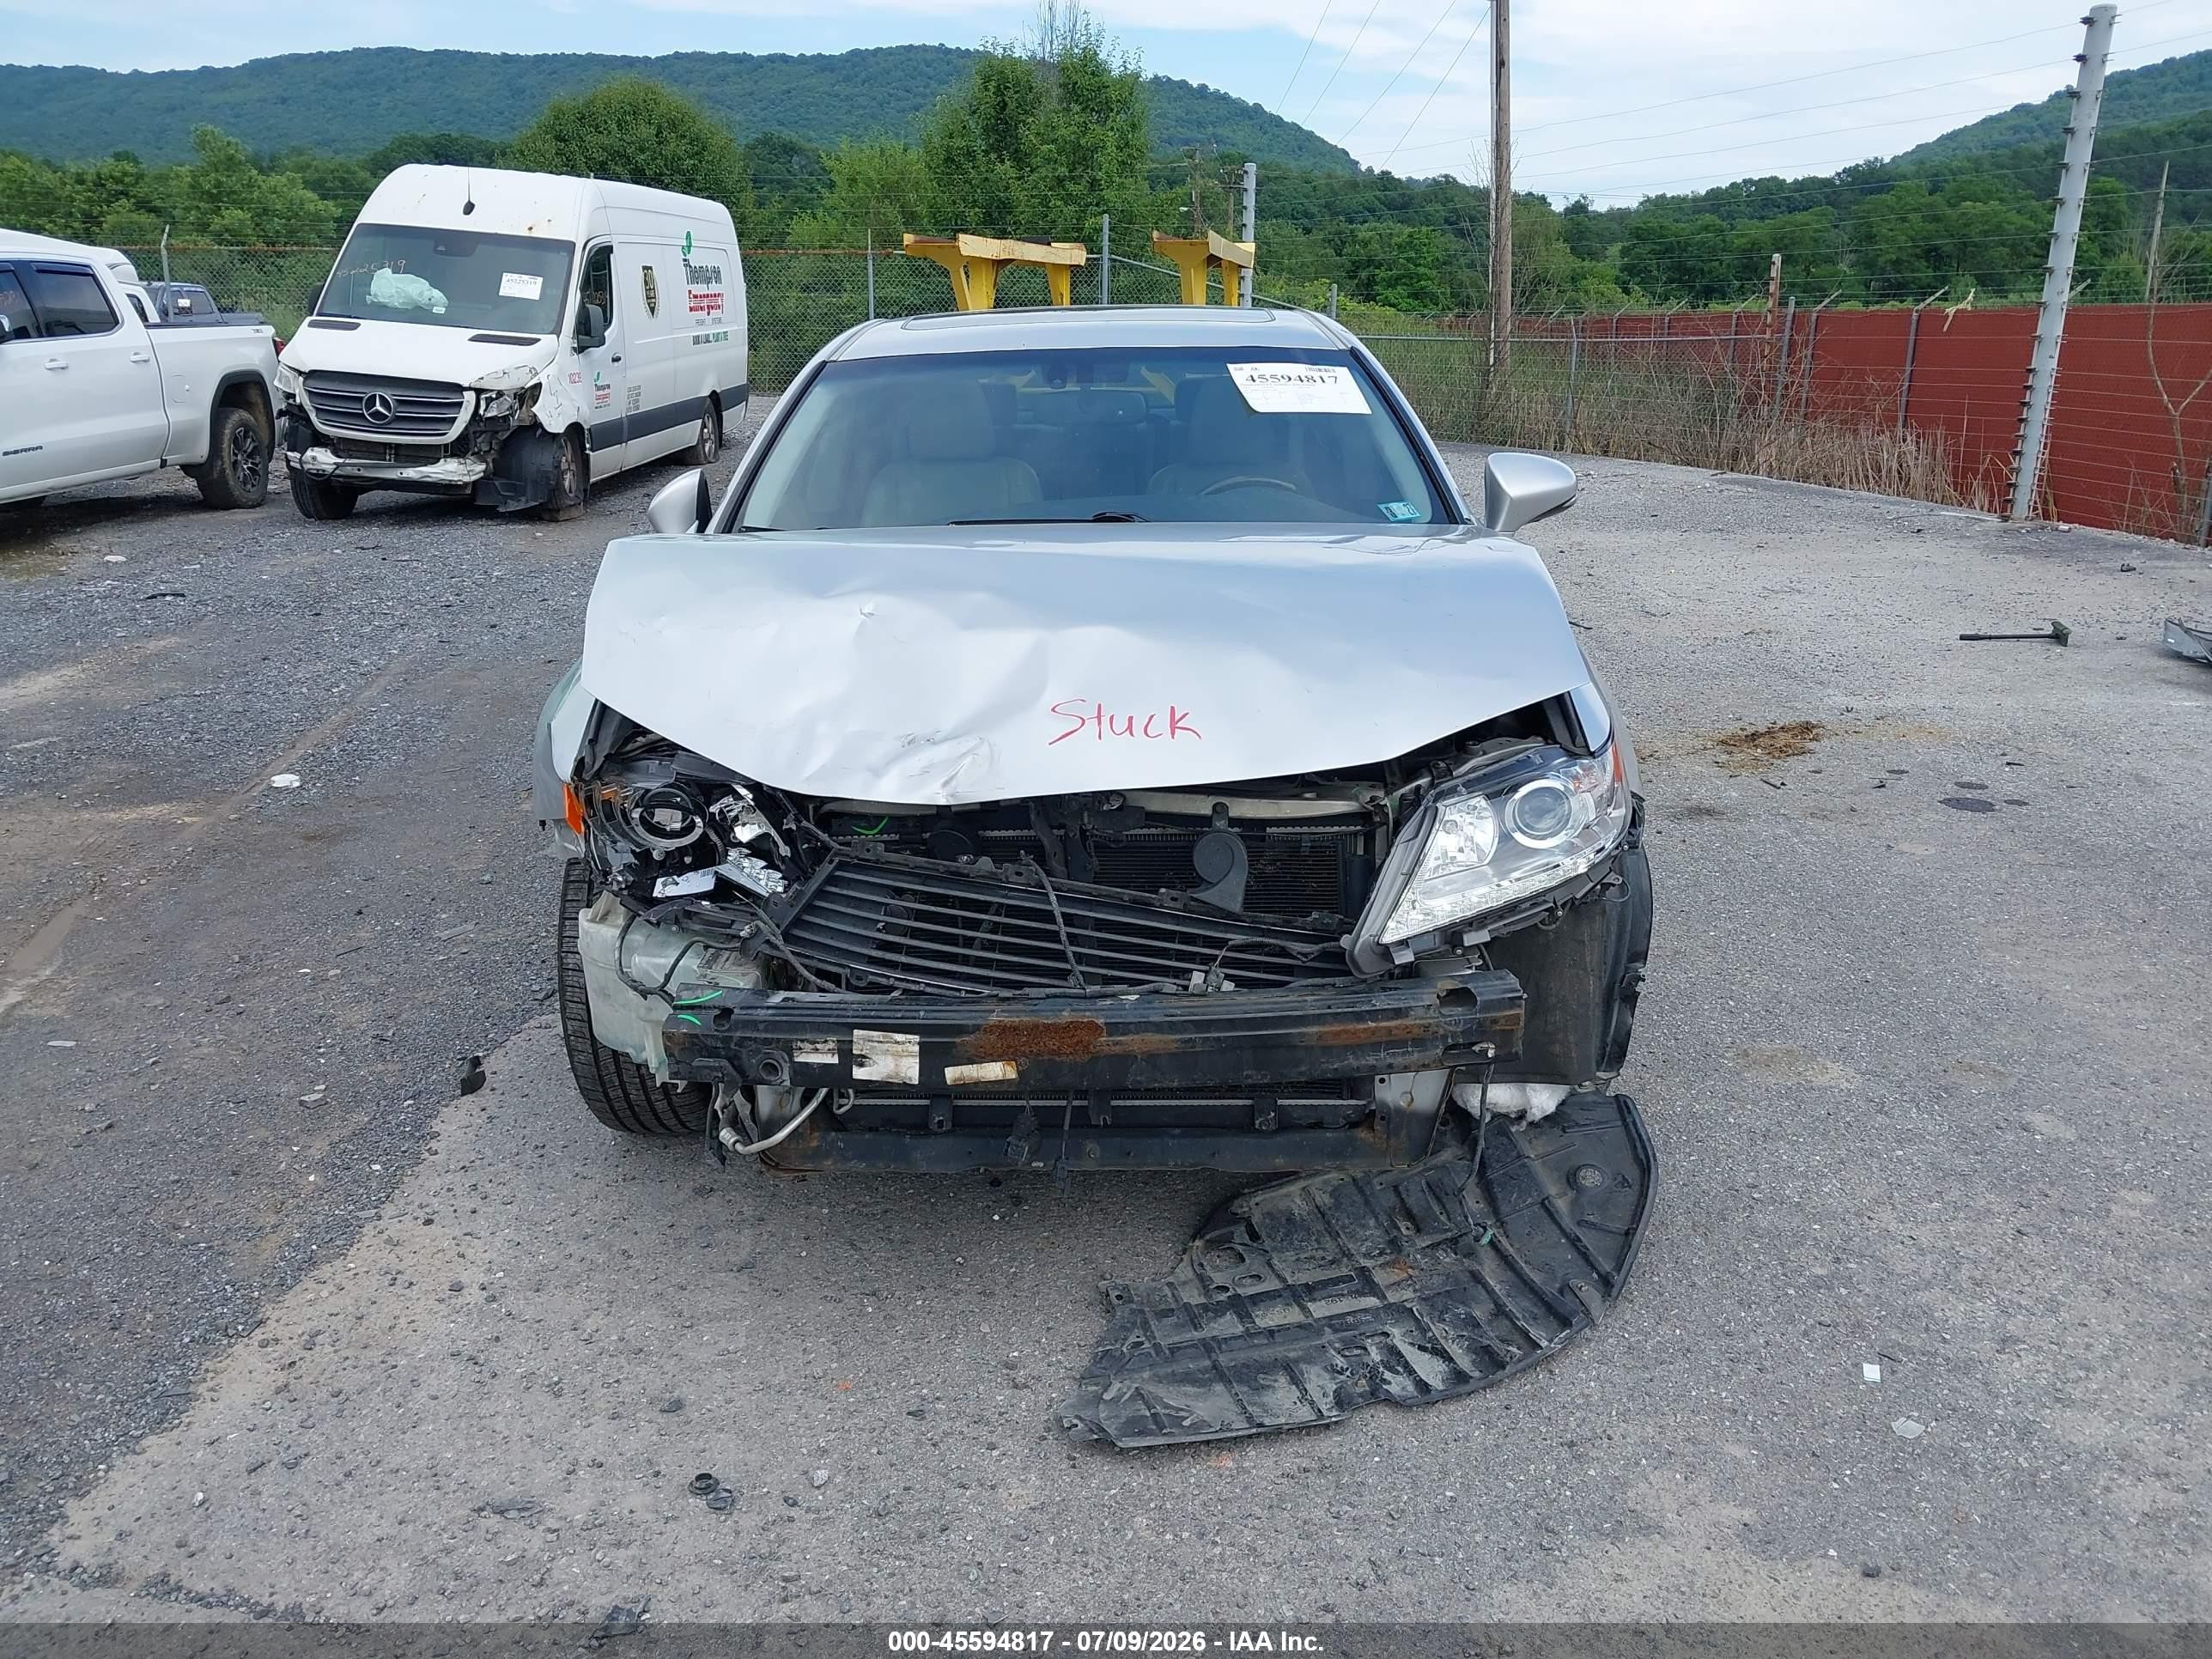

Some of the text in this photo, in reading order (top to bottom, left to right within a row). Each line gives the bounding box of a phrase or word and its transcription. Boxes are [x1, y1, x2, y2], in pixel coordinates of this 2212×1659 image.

[643, 269, 653, 289] 30
[682, 258, 722, 290] Thompson
[688, 289, 724, 316] Emergency
[1245, 374, 1338, 385] 45594817
[2, 445, 43, 457] SIERRA
[1048, 698, 1202, 746] Stuck
